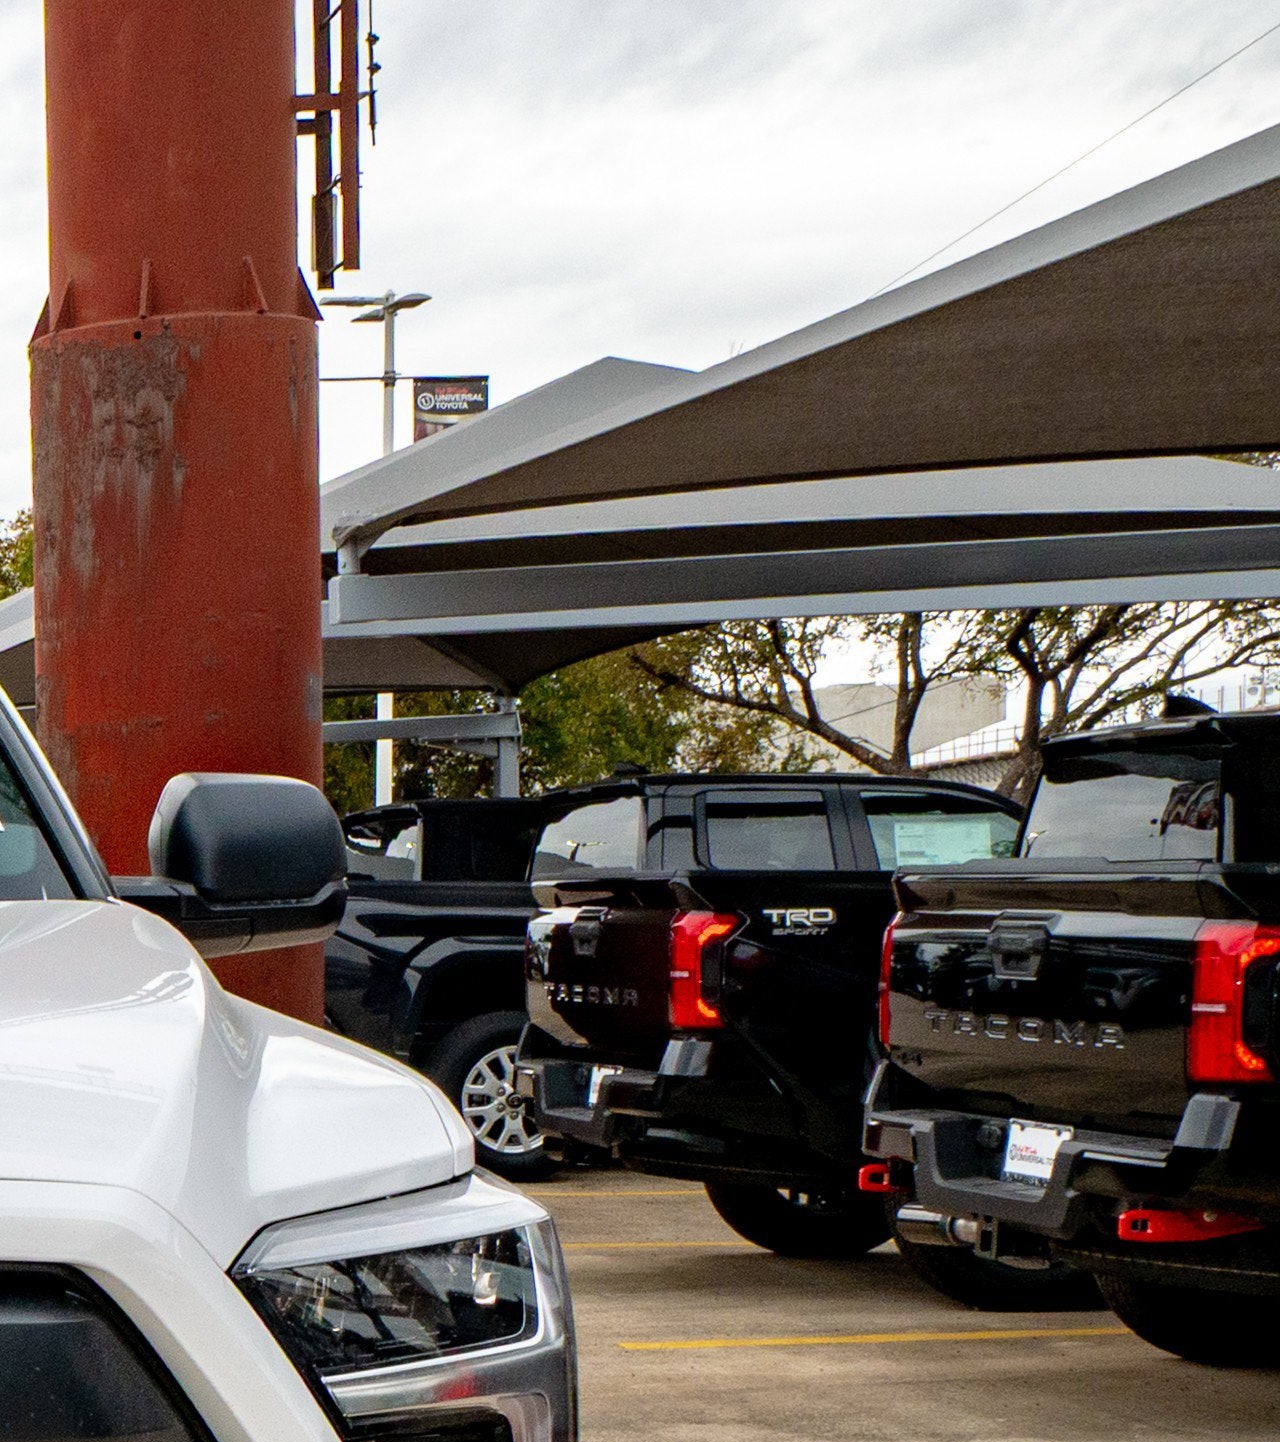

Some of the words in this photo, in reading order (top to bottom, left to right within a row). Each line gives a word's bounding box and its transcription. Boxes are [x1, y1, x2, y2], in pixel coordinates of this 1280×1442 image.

[435, 393, 484, 402] UNIVERSAL
[435, 402, 469, 410] TOYOTA
[762, 908, 836, 926] TRD
[772, 926, 829, 936] SPORT
[543, 981, 639, 1007] TACOMA
[924, 1008, 1125, 1050] TACOMA
